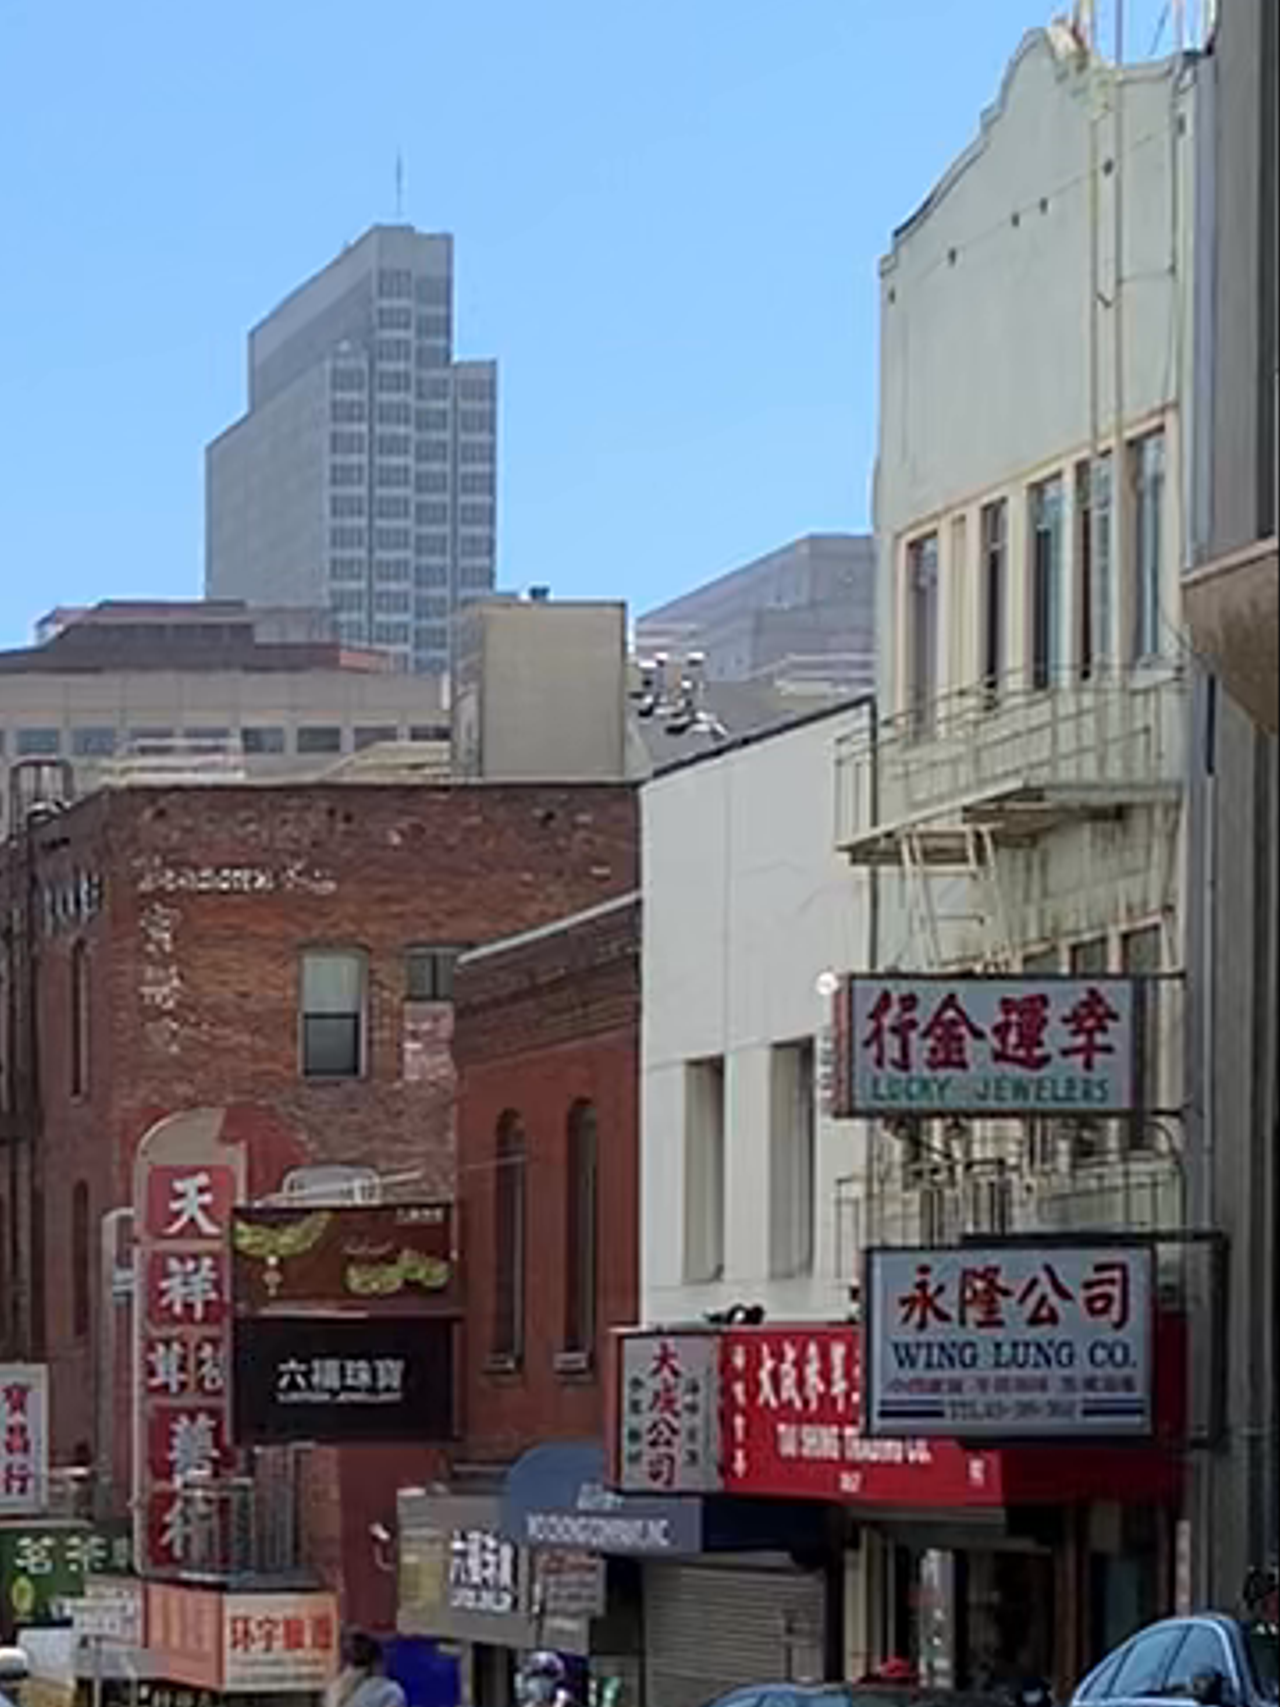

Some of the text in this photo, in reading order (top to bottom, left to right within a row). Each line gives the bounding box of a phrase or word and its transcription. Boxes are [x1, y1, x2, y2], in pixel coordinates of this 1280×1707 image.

[871, 1076, 952, 1102] LUCKY
[898, 1262, 1130, 1332] 永隆公司
[891, 1339, 1138, 1370] WING LUNG CO.
